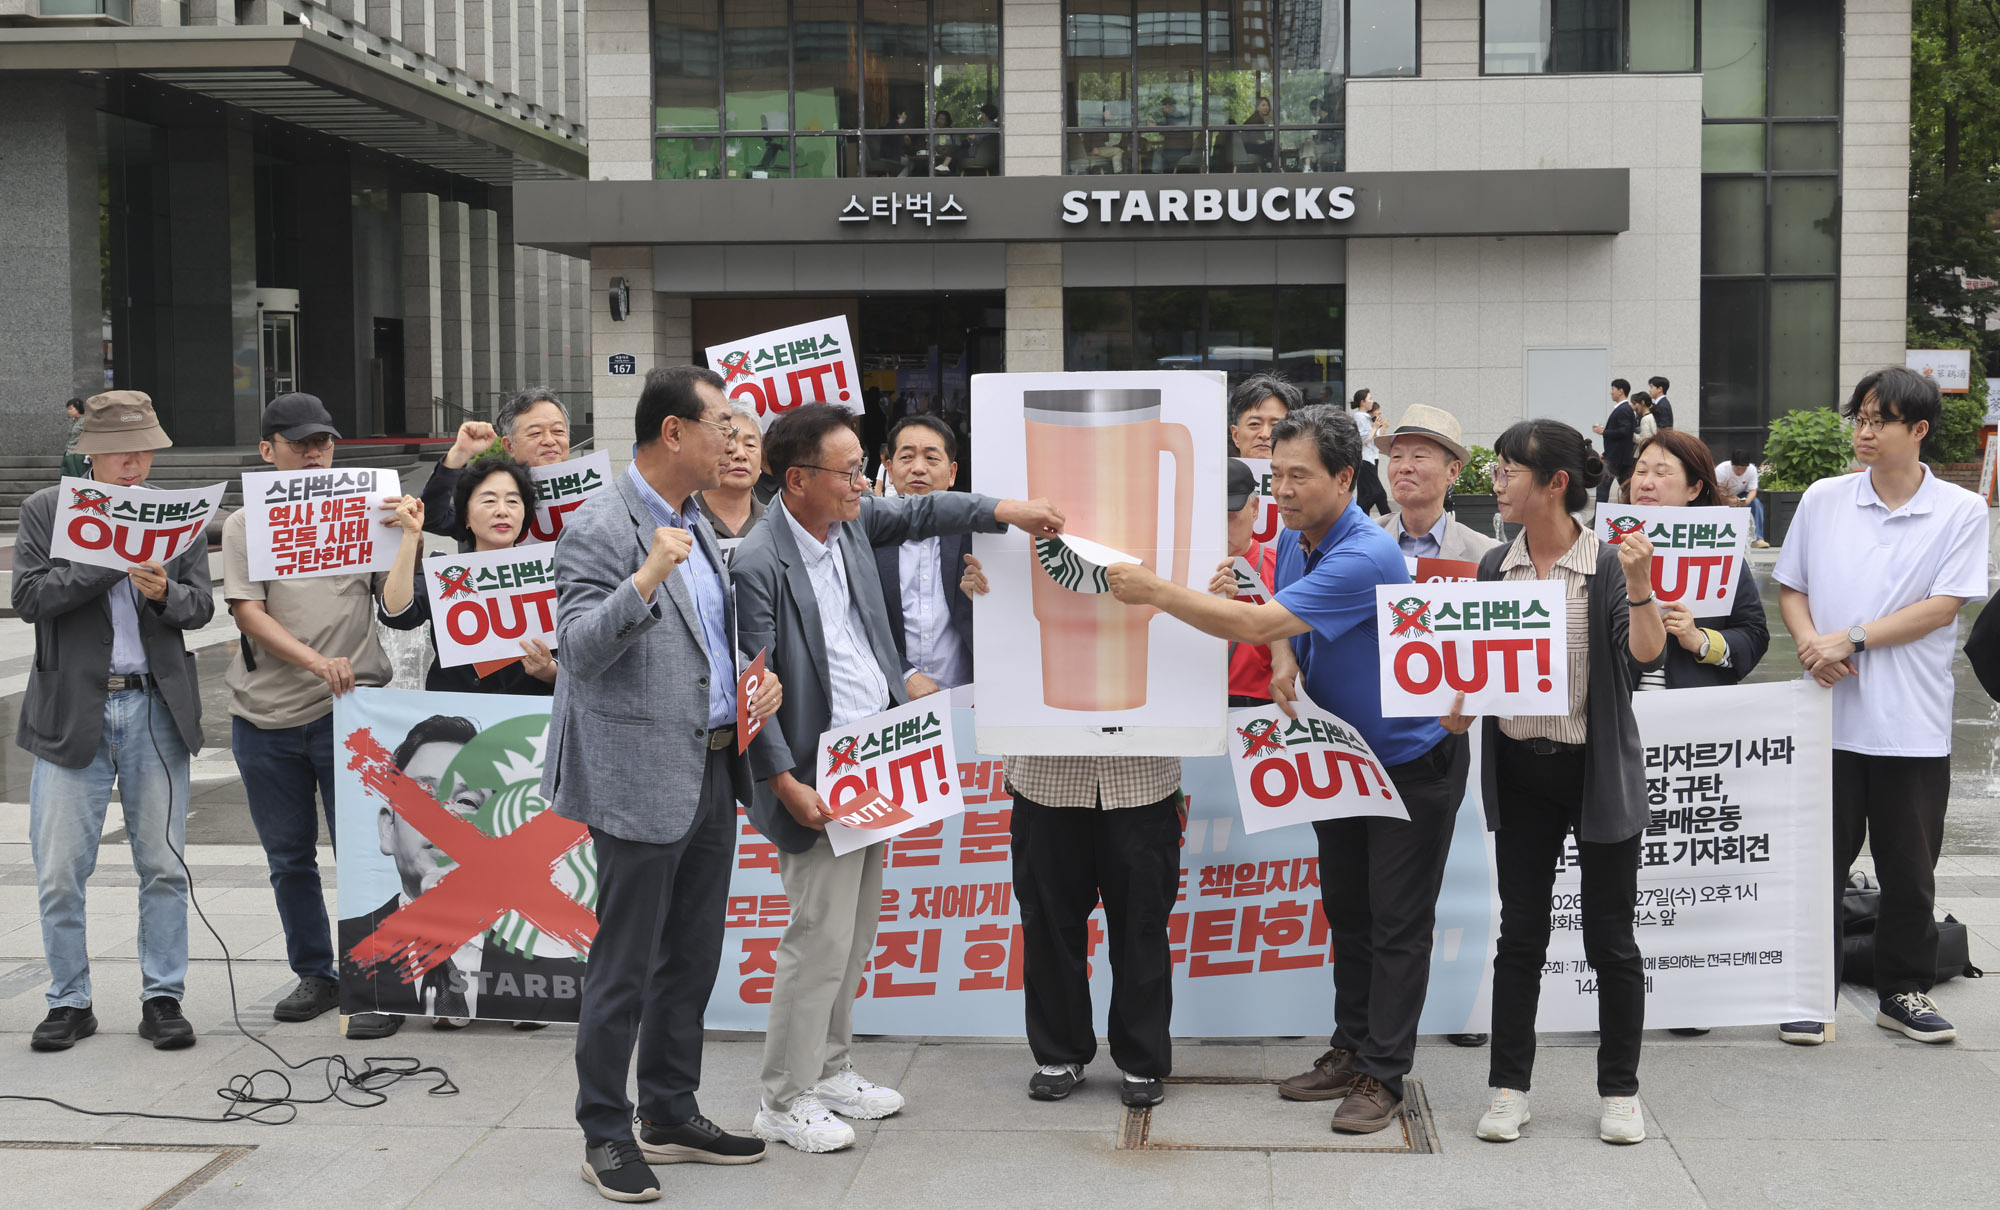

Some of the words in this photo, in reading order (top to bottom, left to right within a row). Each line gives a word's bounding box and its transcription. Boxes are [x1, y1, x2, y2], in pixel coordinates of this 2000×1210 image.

[839, 191, 967, 226] 스타벅스
[1062, 186, 1355, 223] STARBUCKS
[614, 364, 631, 374] 167
[754, 333, 841, 372] 스타벅스
[729, 361, 850, 417] OUT!
[265, 471, 377, 504] 스타벅스의
[535, 468, 603, 500] 타벅스
[112, 498, 210, 524] 스타벅스
[268, 502, 314, 528] 역사
[67, 515, 205, 564] OUT!
[271, 525, 317, 552] 모독
[324, 518, 369, 545] 사태
[1648, 523, 1737, 549] 스타벅스
[275, 541, 373, 576] 규탄한다!
[1650, 555, 1733, 602] UT!
[1434, 599, 1550, 631] 스타벅스
[1393, 638, 1552, 695] OUT!
[860, 711, 941, 762] 스타벅스
[1284, 718, 1369, 755] 스타벅스
[1641, 739, 1742, 773] 리자르기
[1745, 735, 1795, 767] 사과
[829, 744, 950, 828] OUT!
[1250, 750, 1392, 808] OUT!
[1673, 773, 1728, 804] 규탄,
[839, 796, 893, 826] OUT!
[1646, 805, 1742, 836] 불매운동
[1673, 833, 1770, 866] 기자회견
[1700, 884, 1732, 903] 오후
[1734, 883, 1757, 901] 1시
[725, 894, 791, 928] 모든
[1660, 908, 1677, 926] 앞
[1541, 961, 1564, 974] 주최
[1658, 954, 1705, 970] 동의하는
[1707, 952, 1731, 968] 전국
[1733, 951, 1757, 966] 단체
[1759, 950, 1783, 965] 연명
[448, 970, 584, 999] STARB
